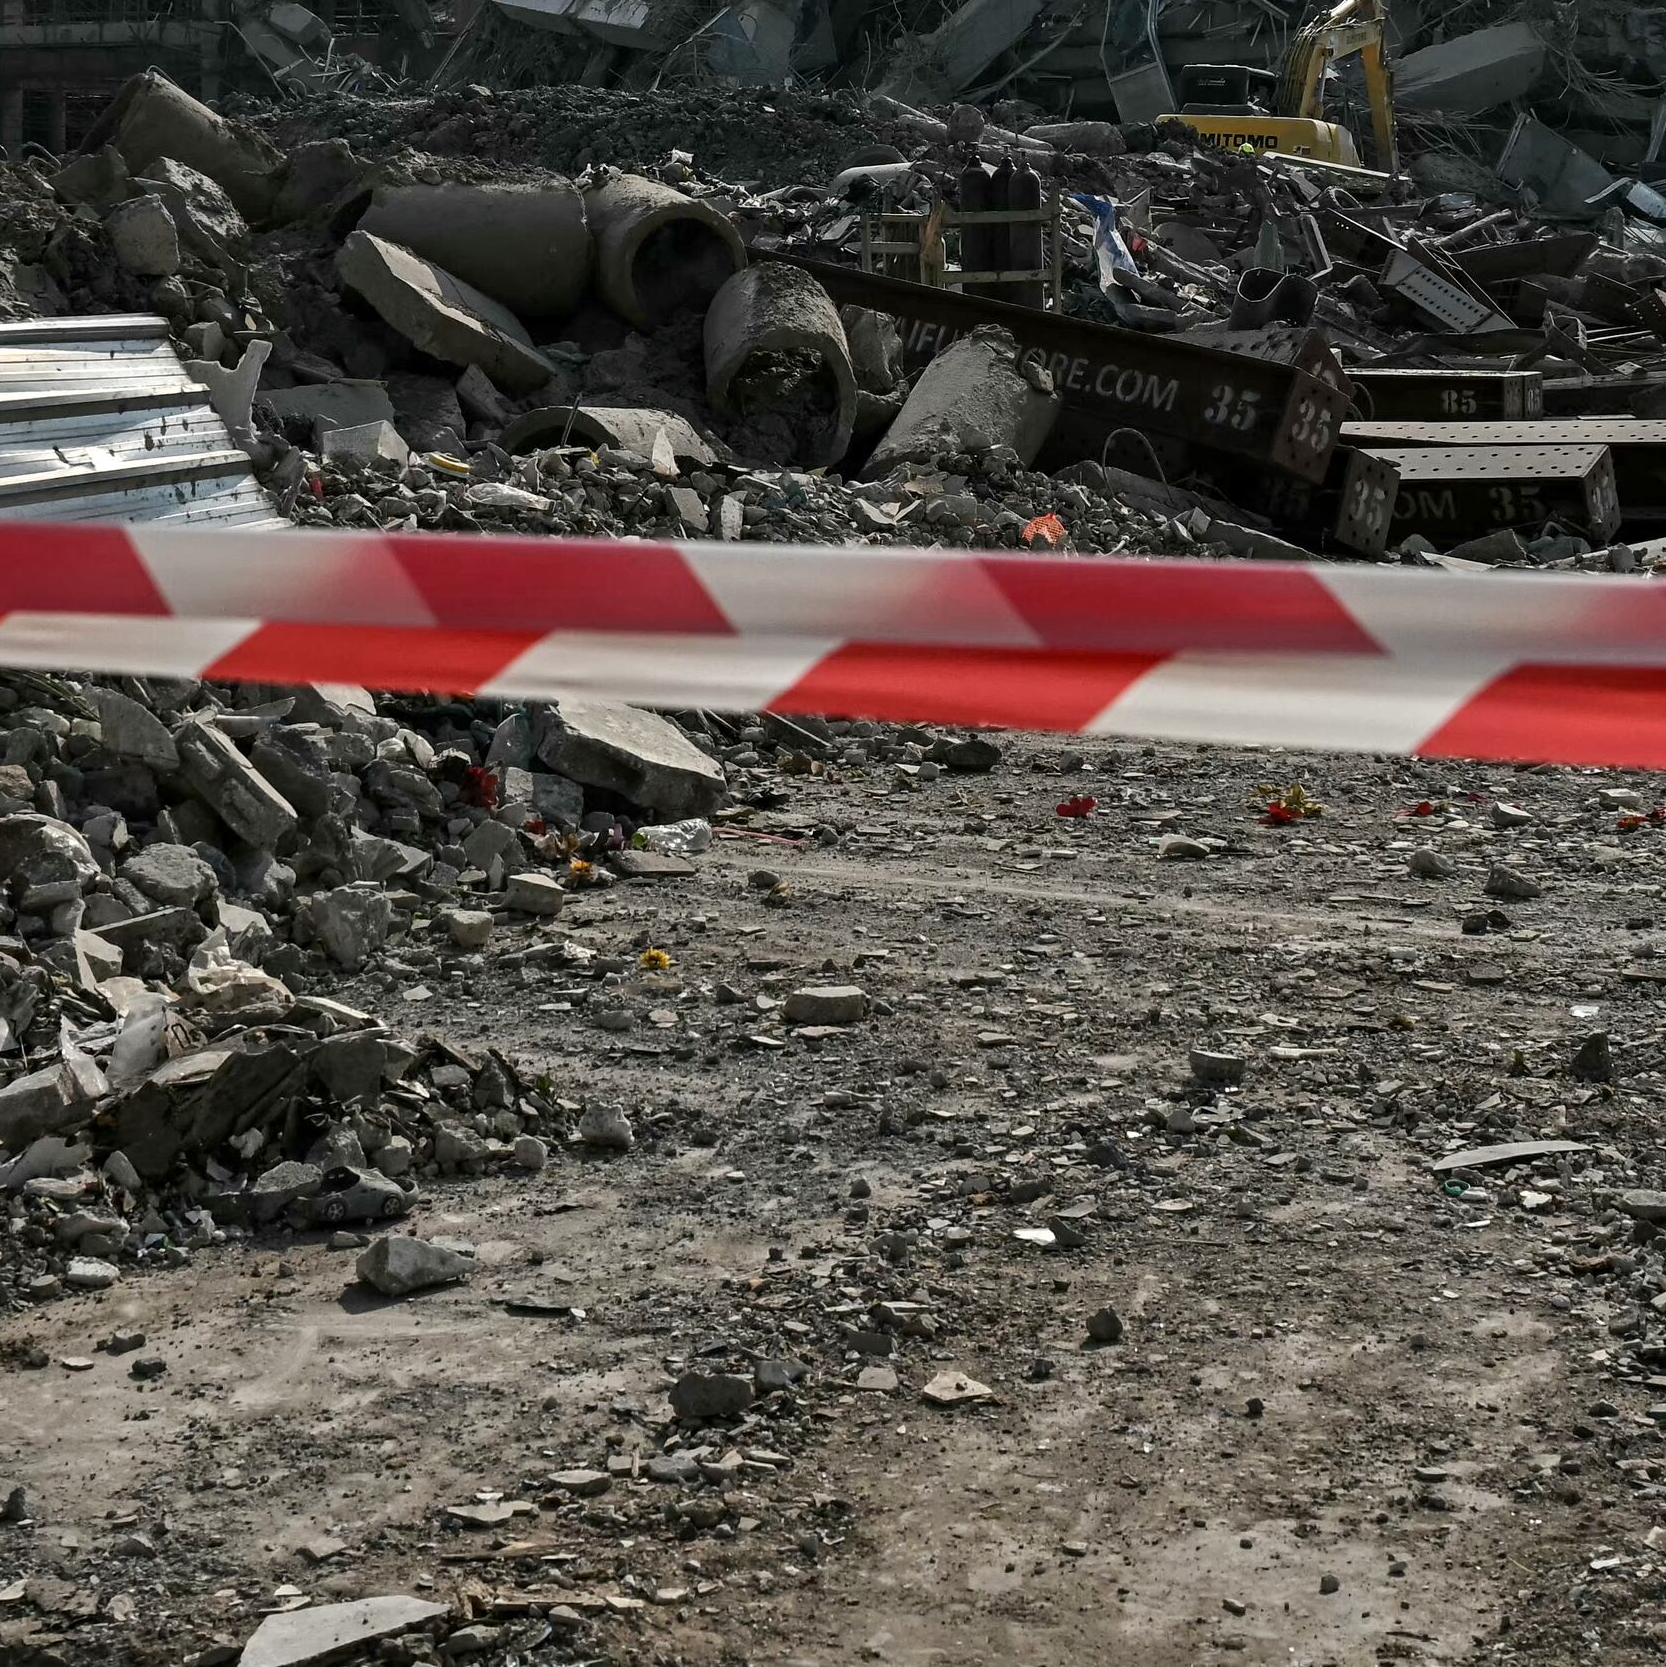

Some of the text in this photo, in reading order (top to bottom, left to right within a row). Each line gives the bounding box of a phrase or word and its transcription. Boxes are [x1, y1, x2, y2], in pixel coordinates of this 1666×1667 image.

[1199, 132, 1278, 149] MITOMO
[1204, 384, 1261, 430] 35
[1291, 399, 1332, 453] 35
[1351, 478, 1386, 530] 35
[1487, 486, 1547, 522] 35
